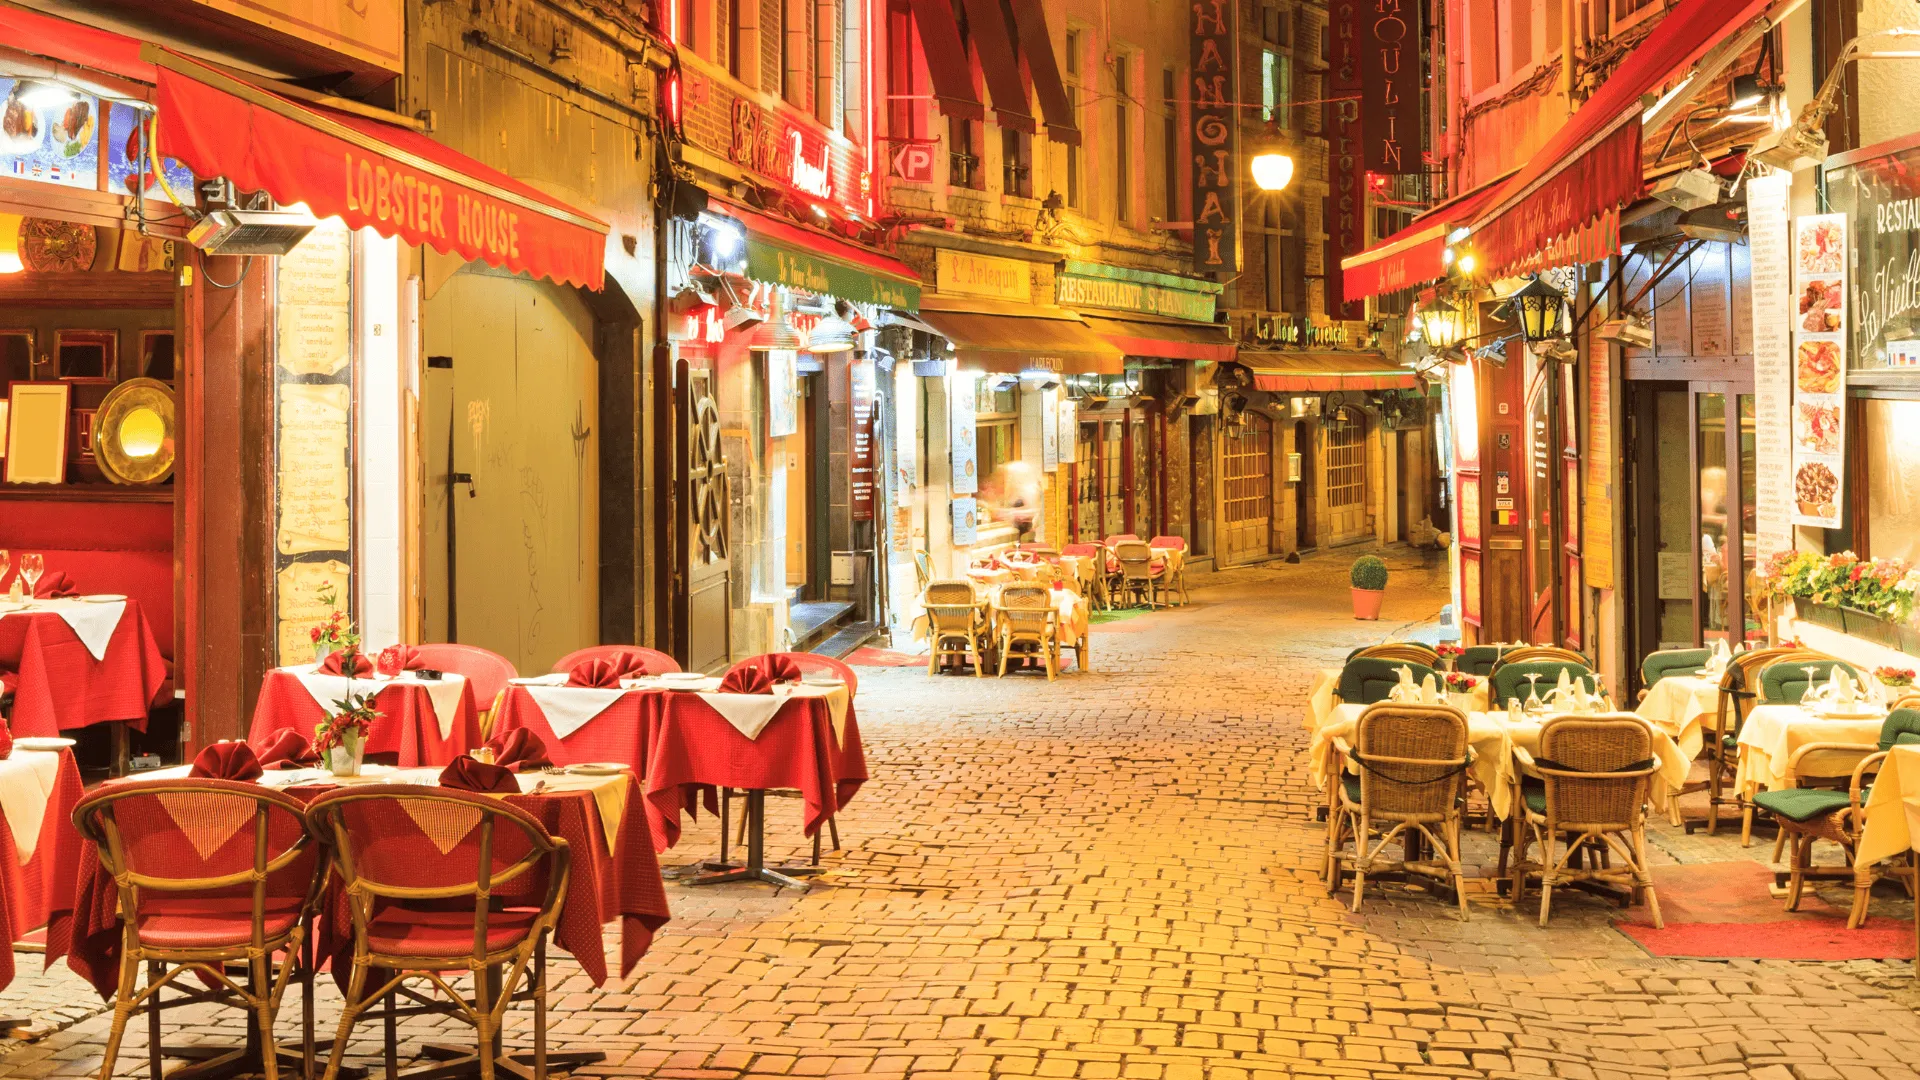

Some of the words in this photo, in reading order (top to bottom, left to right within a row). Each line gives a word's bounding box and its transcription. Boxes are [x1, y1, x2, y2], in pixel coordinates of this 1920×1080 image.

[907, 150, 930, 178] P
[345, 153, 447, 239] LOBSTER
[456, 194, 519, 260] HOUSE
[1058, 276, 1143, 310] RESTAURANT
